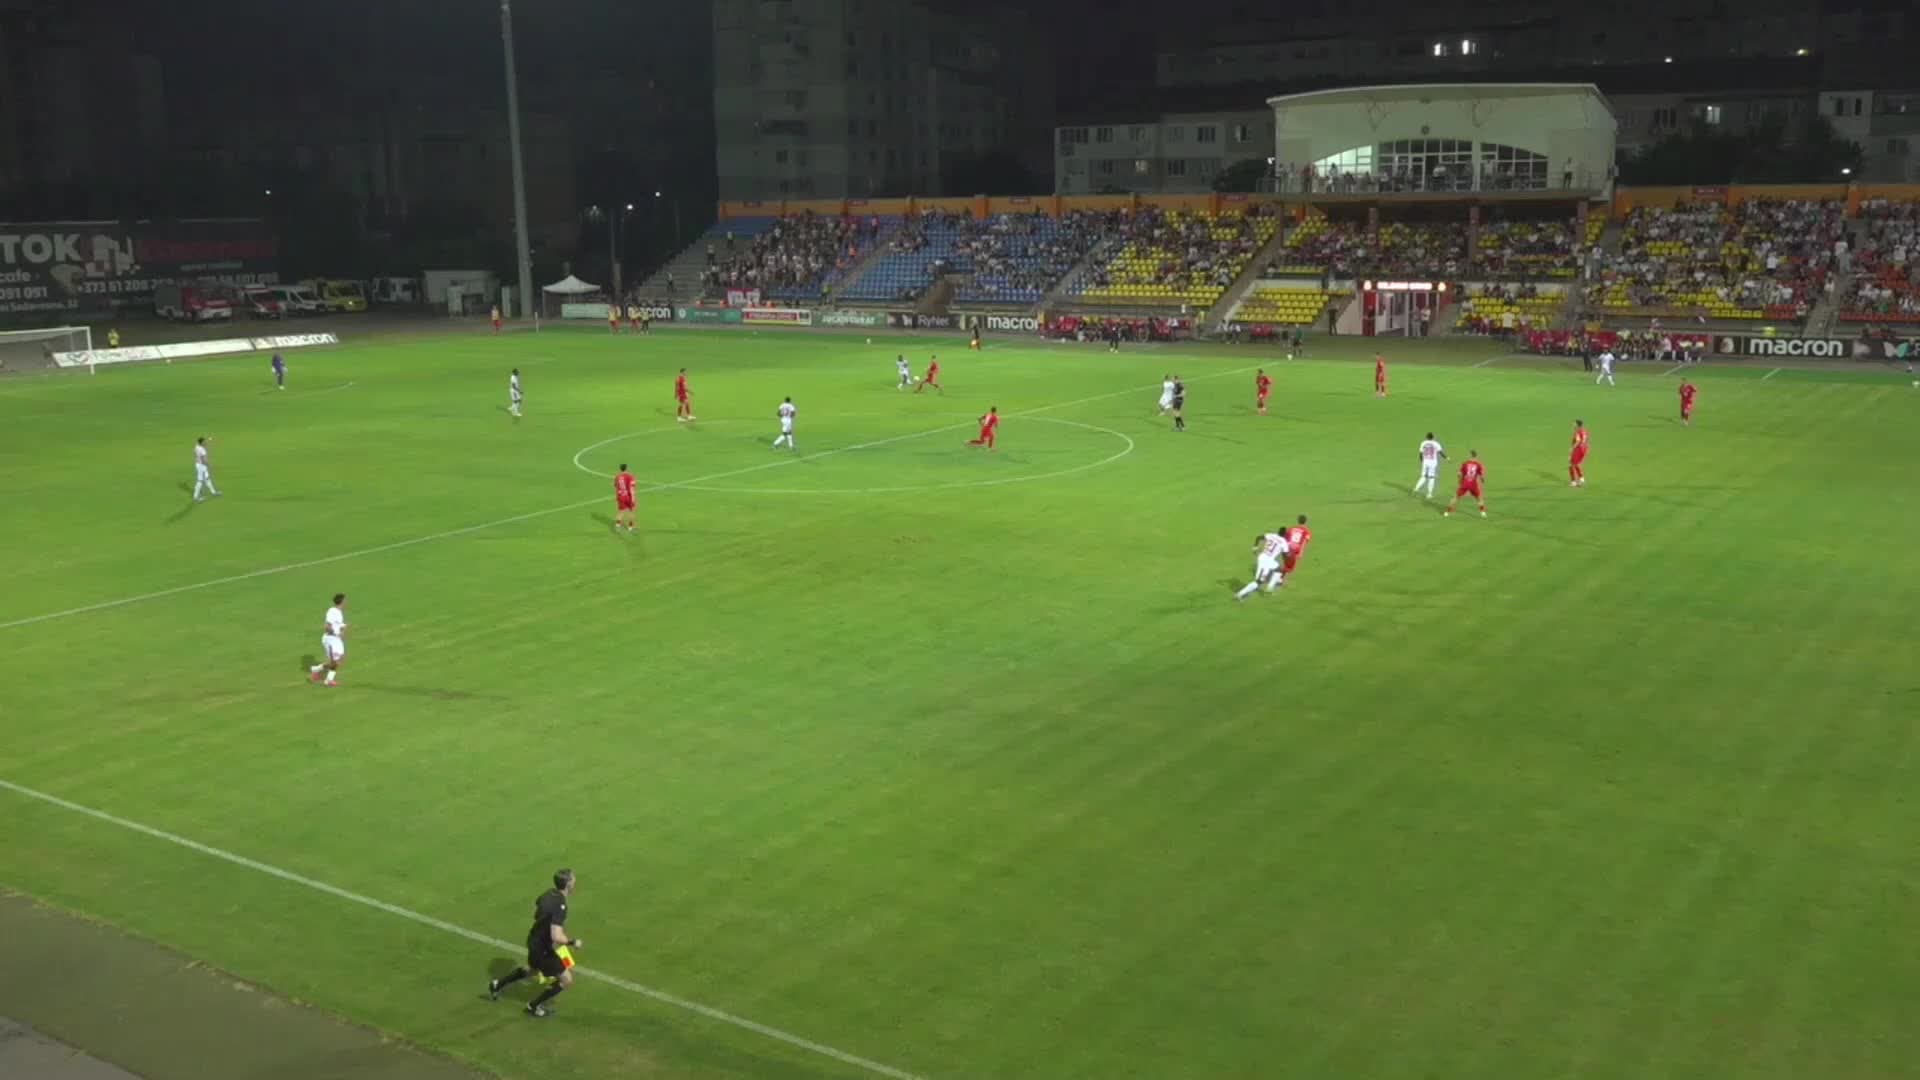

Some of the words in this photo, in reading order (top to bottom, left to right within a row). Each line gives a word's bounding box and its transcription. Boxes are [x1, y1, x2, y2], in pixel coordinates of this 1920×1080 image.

[0, 234, 81, 264] TOK
[276, 333, 333, 347] macron
[1749, 337, 1844, 357] macron
